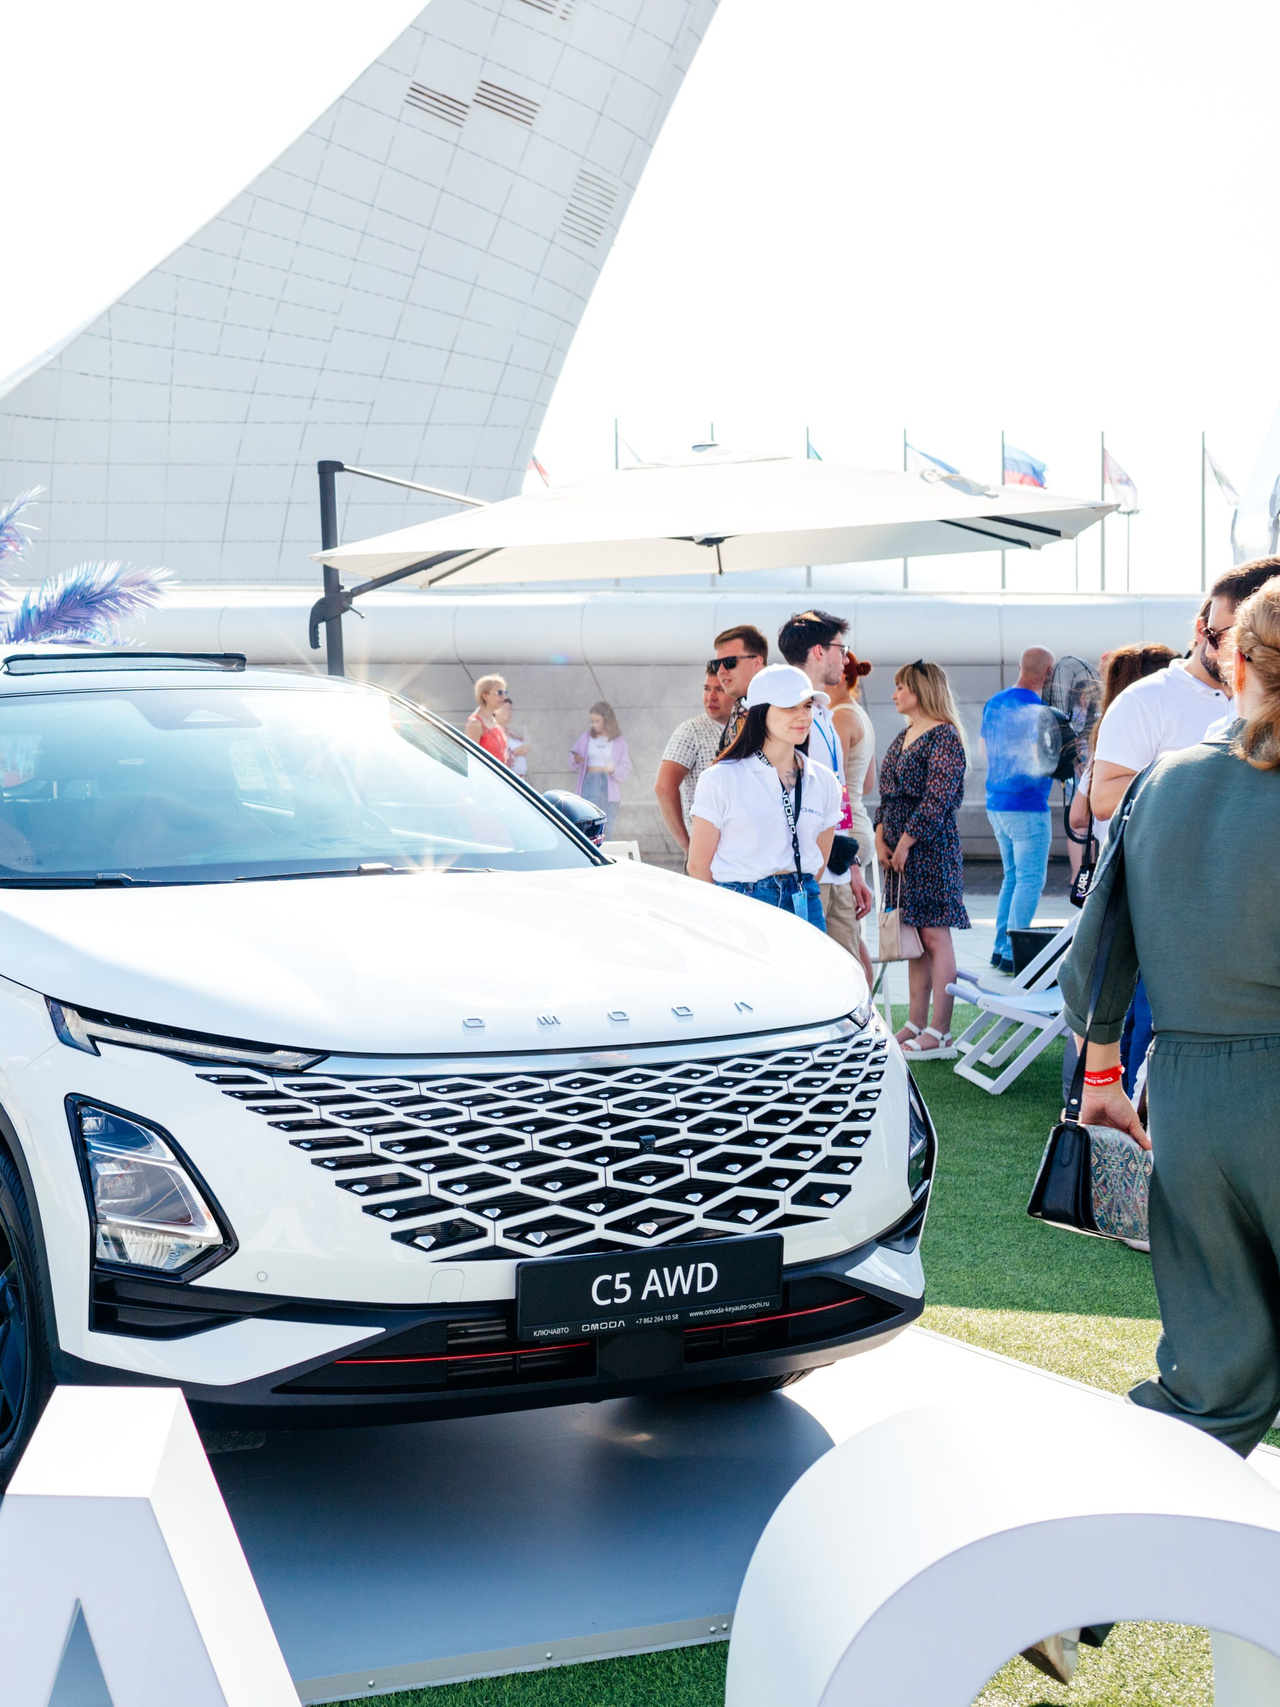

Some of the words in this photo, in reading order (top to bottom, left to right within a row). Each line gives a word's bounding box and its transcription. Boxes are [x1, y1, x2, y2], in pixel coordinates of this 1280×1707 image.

[591, 1272, 632, 1306] C5
[641, 1262, 719, 1301] AWD
[689, 1301, 770, 1318] www.omoda-keyauto-sochi.ru
[533, 1327, 570, 1337] КЛЮЧАВТО
[582, 1320, 626, 1332] OMODA
